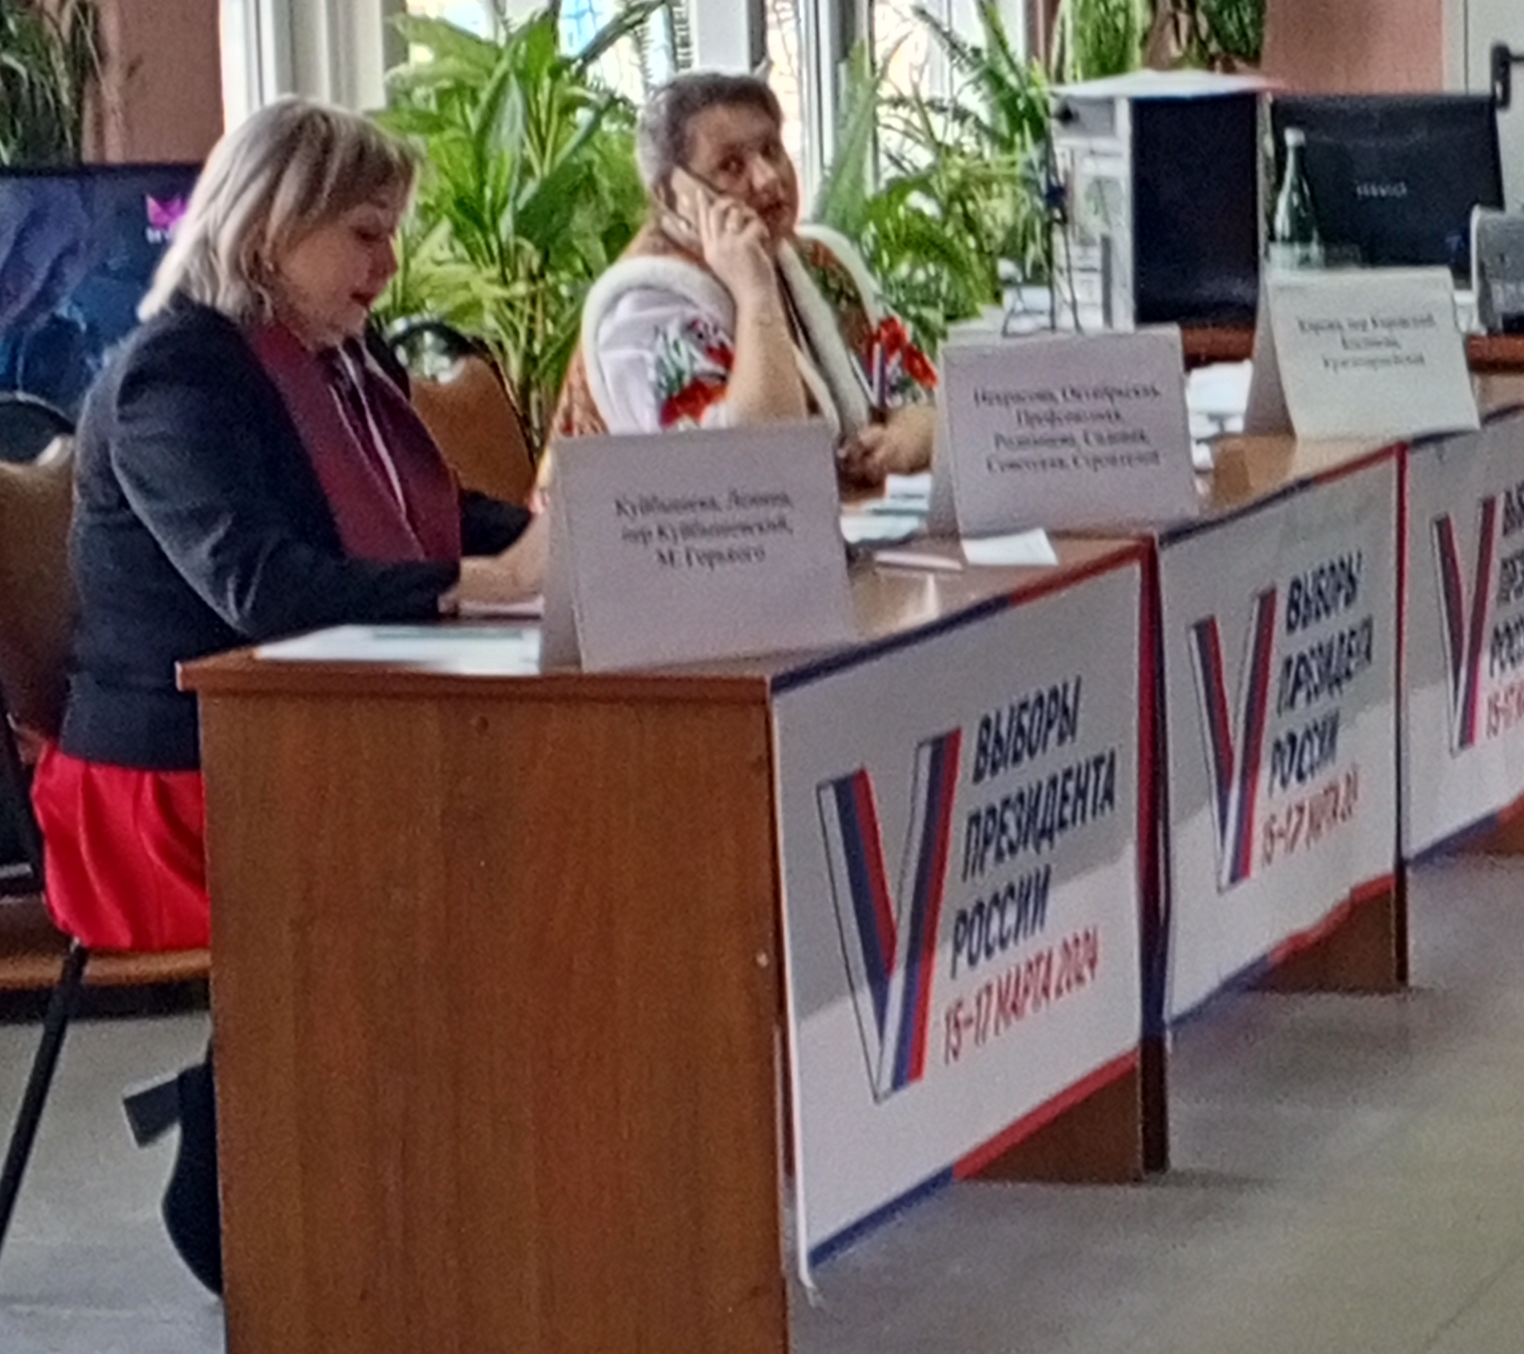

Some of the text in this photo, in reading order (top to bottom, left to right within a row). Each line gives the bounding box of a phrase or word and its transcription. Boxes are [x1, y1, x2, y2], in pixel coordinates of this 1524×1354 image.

[972, 674, 1082, 785] ВЫБОРЫ
[963, 749, 1116, 883] ПРЕЗИДЕНТА
[950, 862, 1051, 980] РОССИИ
[994, 947, 1053, 1037] МАРТА
[1055, 925, 1099, 1001] 2024
